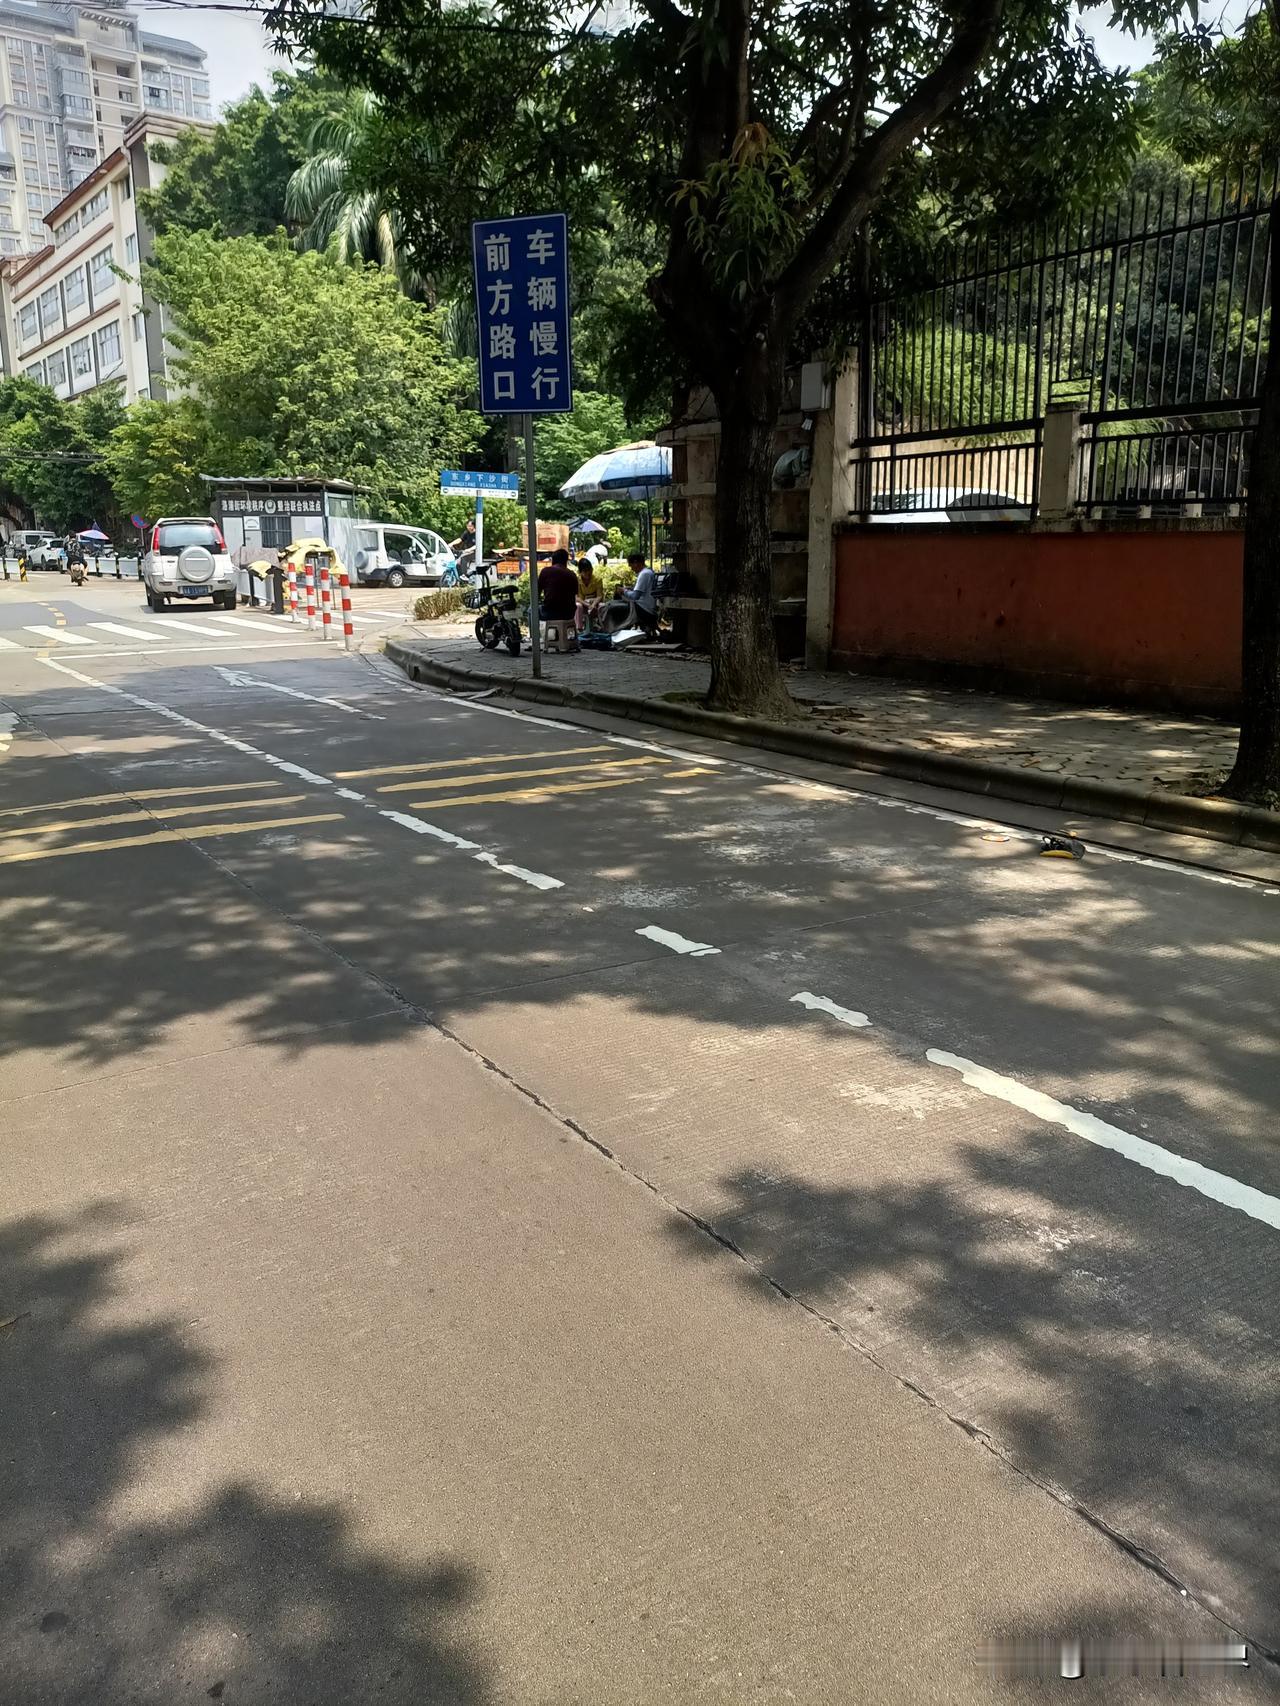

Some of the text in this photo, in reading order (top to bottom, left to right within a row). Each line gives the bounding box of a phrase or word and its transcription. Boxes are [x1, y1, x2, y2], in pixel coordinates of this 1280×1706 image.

[484, 233, 516, 400] 前方路口
[527, 229, 559, 401] 车辆慢行
